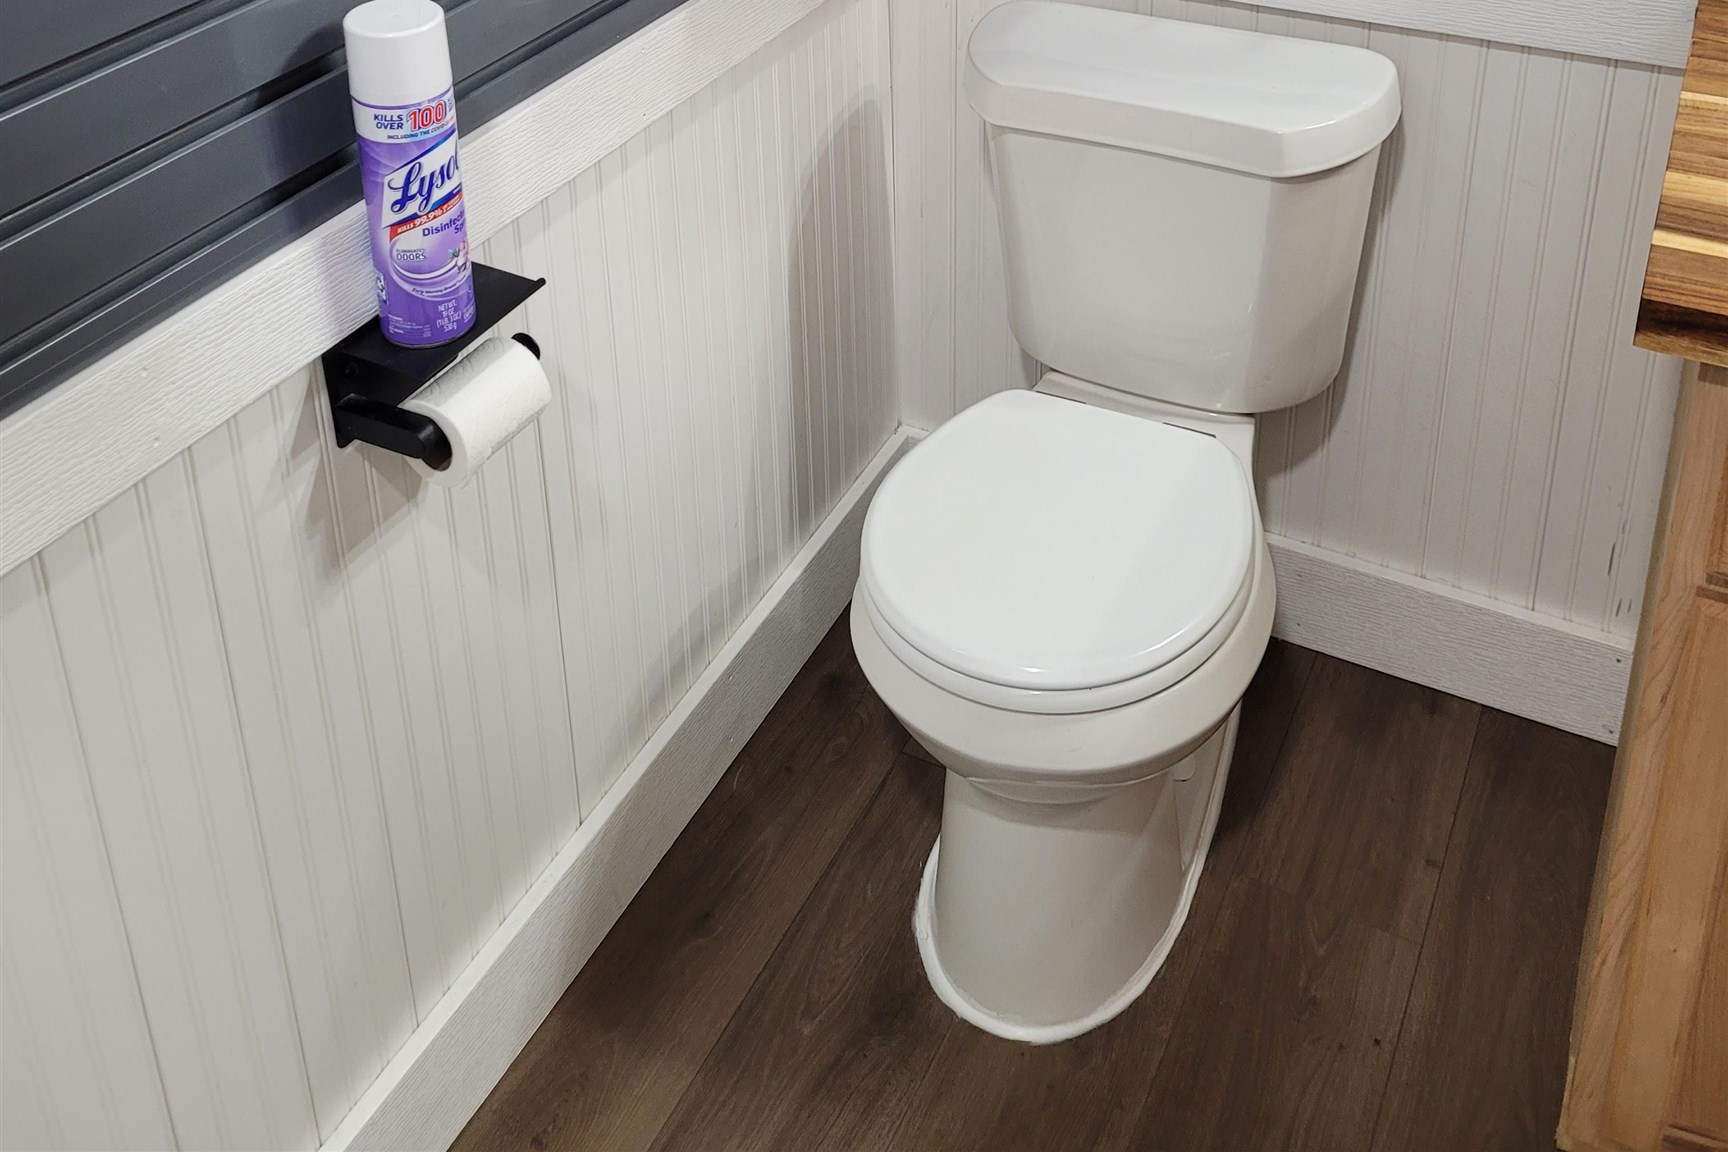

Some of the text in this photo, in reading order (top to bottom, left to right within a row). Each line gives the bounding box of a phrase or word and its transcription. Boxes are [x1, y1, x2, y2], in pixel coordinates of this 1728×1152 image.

[373, 113, 404, 122] KILLS
[406, 100, 447, 132] 100
[375, 121, 404, 130] OVER
[396, 253, 426, 261] ODORS
